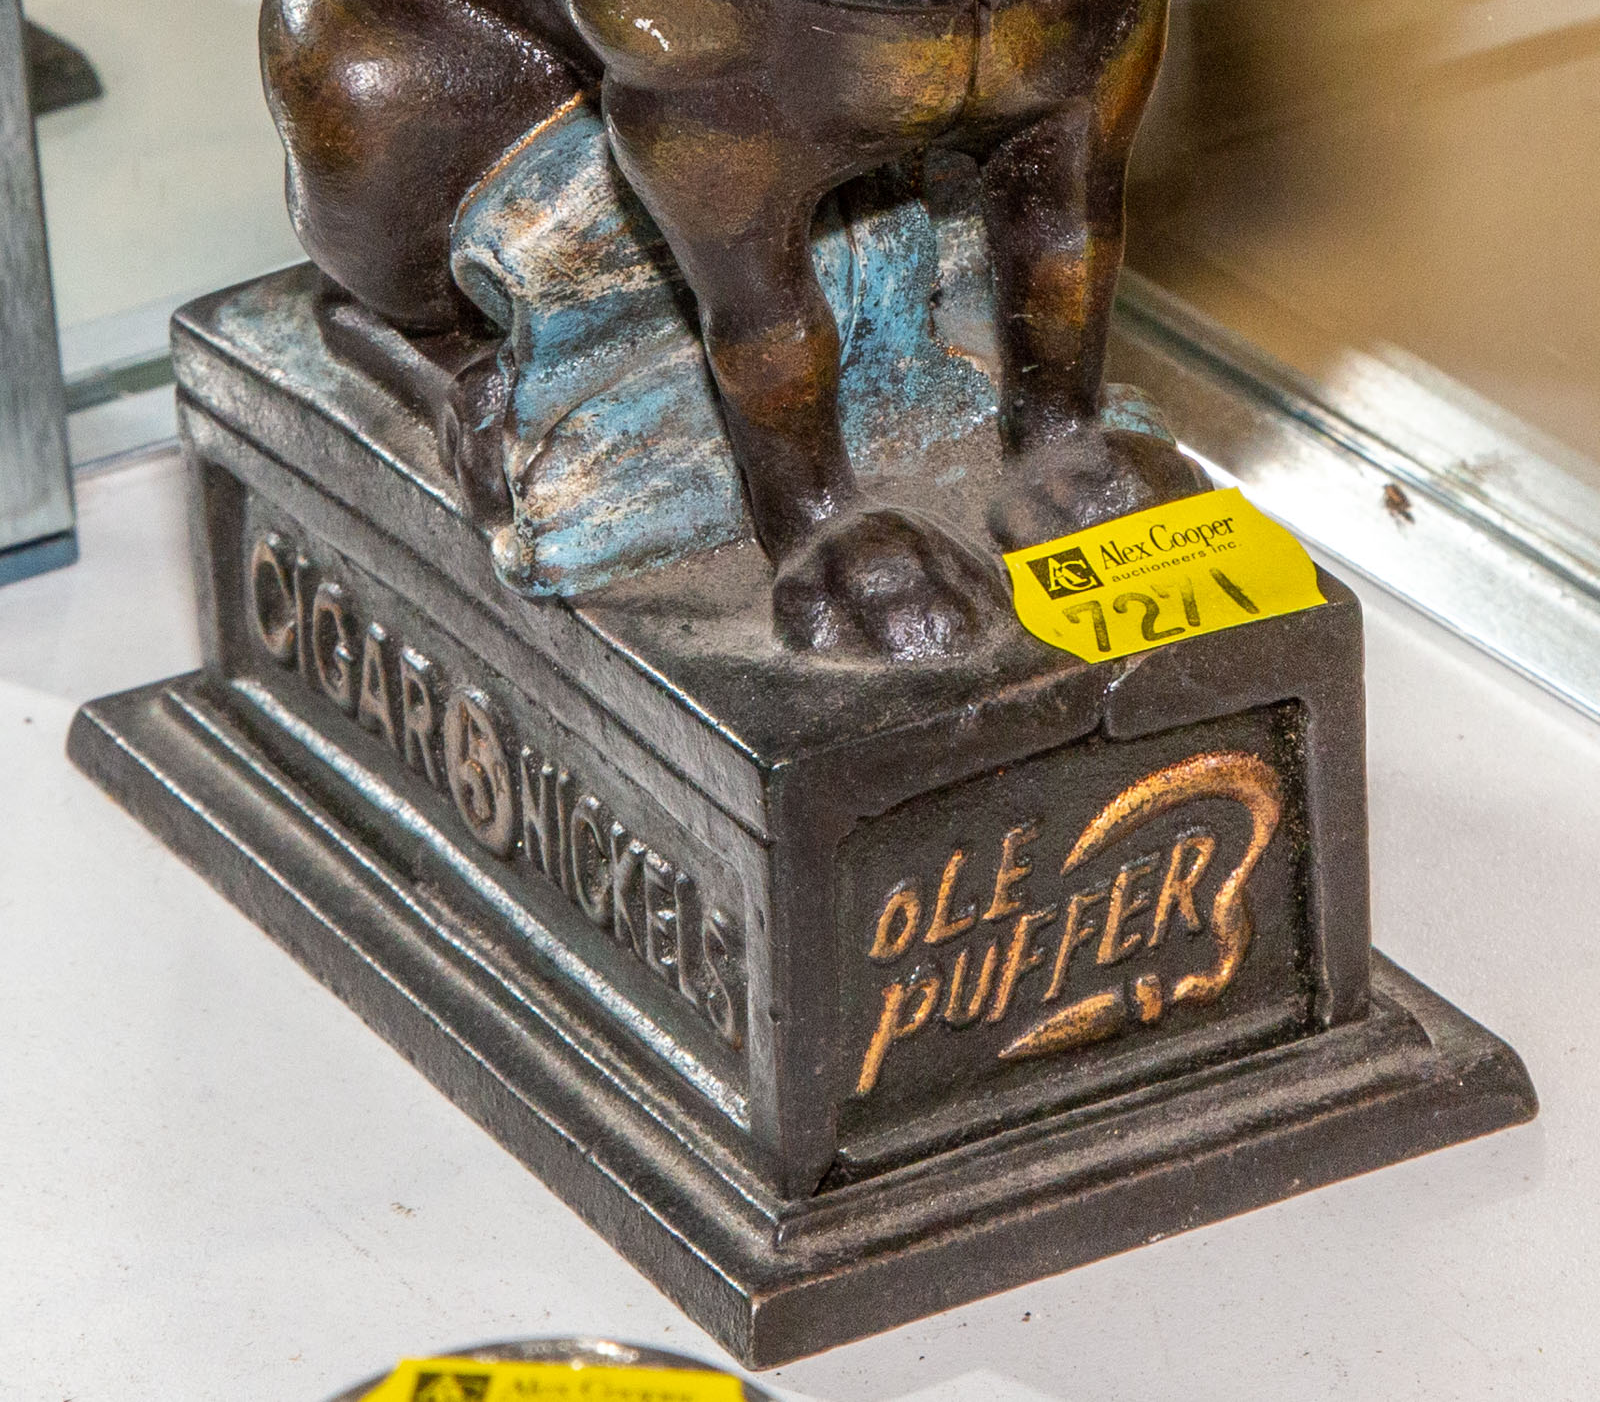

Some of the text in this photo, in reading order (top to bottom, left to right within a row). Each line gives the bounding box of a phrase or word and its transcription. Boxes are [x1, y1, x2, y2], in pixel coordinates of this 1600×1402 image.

[1099, 515, 1235, 570] Alex Cooper
[1111, 547, 1207, 583] auctioneers
[250, 531, 438, 790] CIGAR
[519, 744, 744, 1052] NICKELS
[868, 817, 1042, 965] OLE
